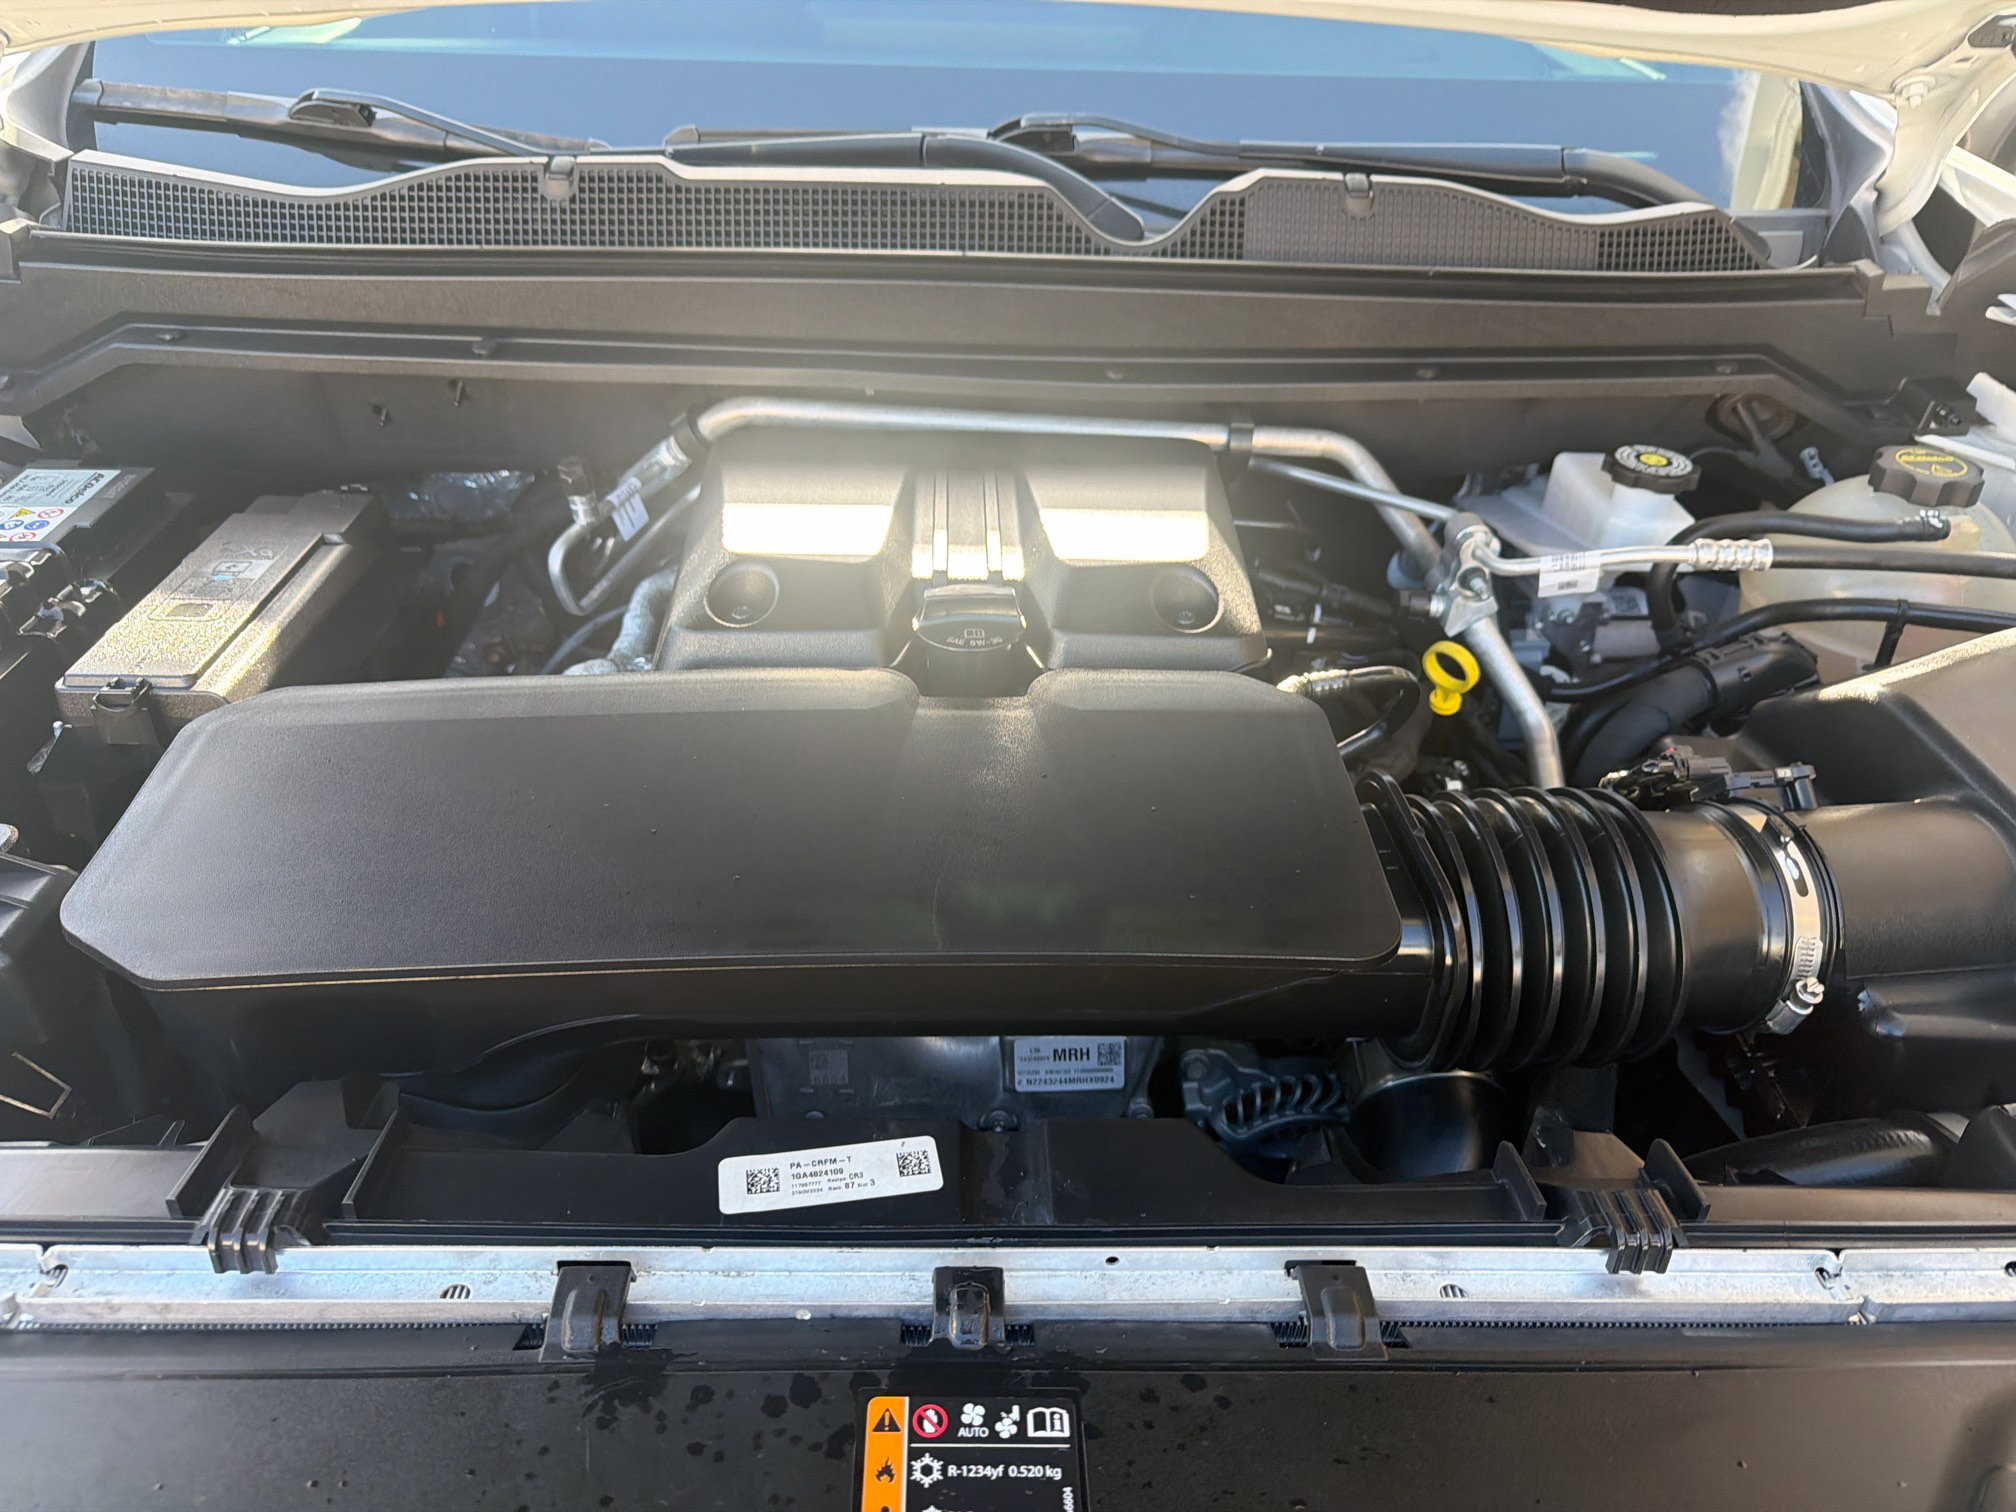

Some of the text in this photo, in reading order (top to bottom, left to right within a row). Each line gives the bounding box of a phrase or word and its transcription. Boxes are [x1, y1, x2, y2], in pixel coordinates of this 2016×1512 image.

[1052, 1047, 1090, 1062] MRH
[848, 1172, 864, 1181] CR3
[844, 1182, 856, 1190] 87
[869, 1178, 876, 1187] 3
[957, 1427, 990, 1438] AUTO
[947, 1464, 1063, 1481] R-1234yf 0.520 kg
